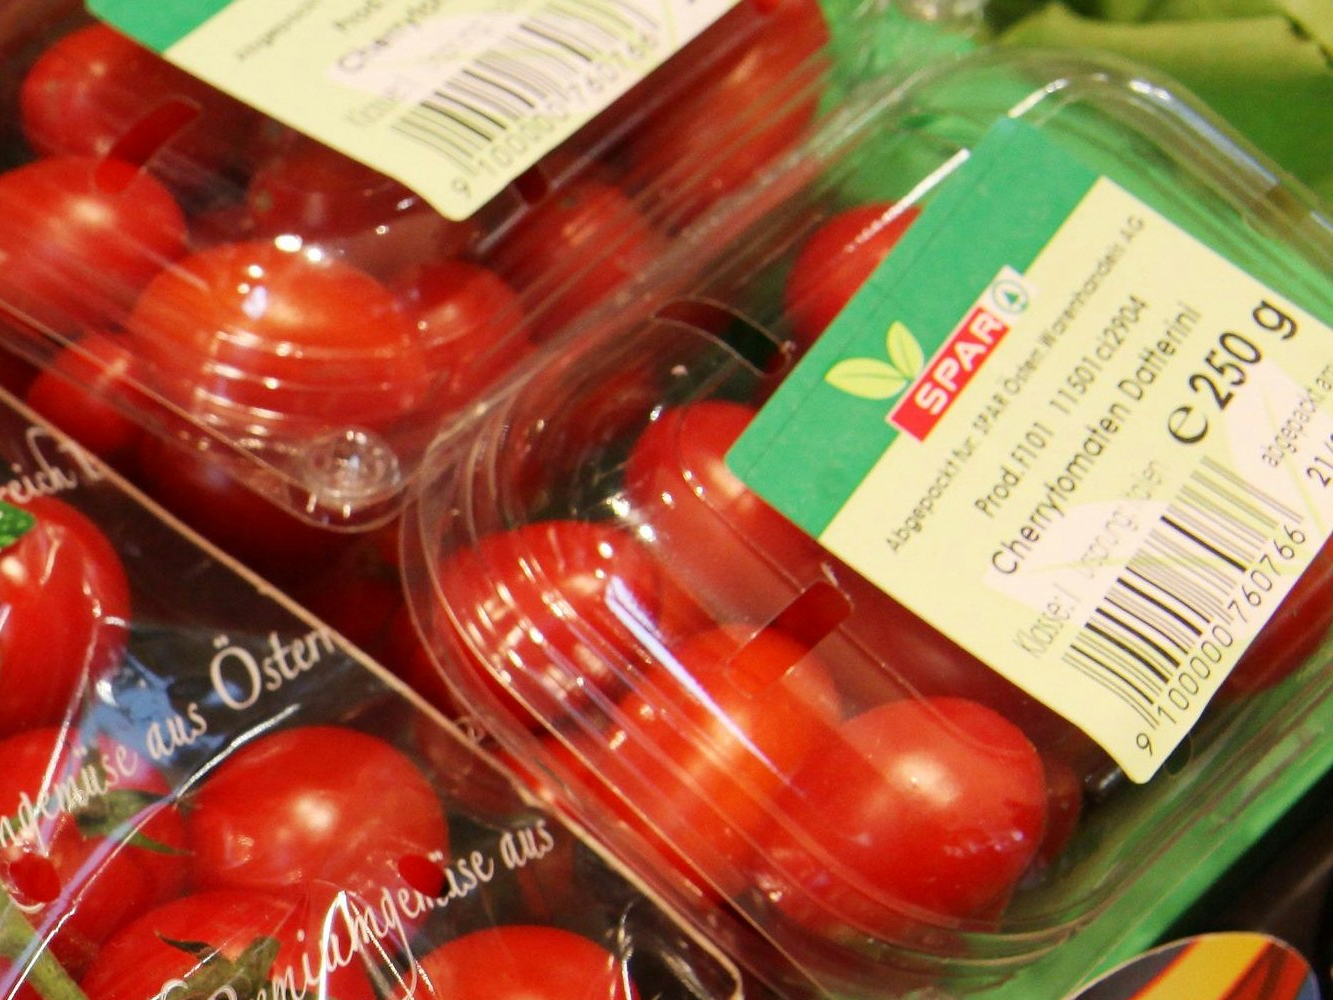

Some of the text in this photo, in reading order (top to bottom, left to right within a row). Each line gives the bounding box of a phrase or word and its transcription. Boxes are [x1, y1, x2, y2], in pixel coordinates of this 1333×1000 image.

[885, 459, 959, 552] Abgepackt
[972, 393, 1009, 437] SPAR
[1119, 213, 1145, 246] AG
[914, 310, 1006, 416] SPAR
[1188, 331, 1263, 411] 250
[1252, 300, 1299, 341] g
[991, 300, 1203, 575] Cherrytomaten Datterini
[1136, 523, 1306, 758] 9 100000 760766
[147, 705, 209, 763] aus
[497, 818, 555, 870] aus
